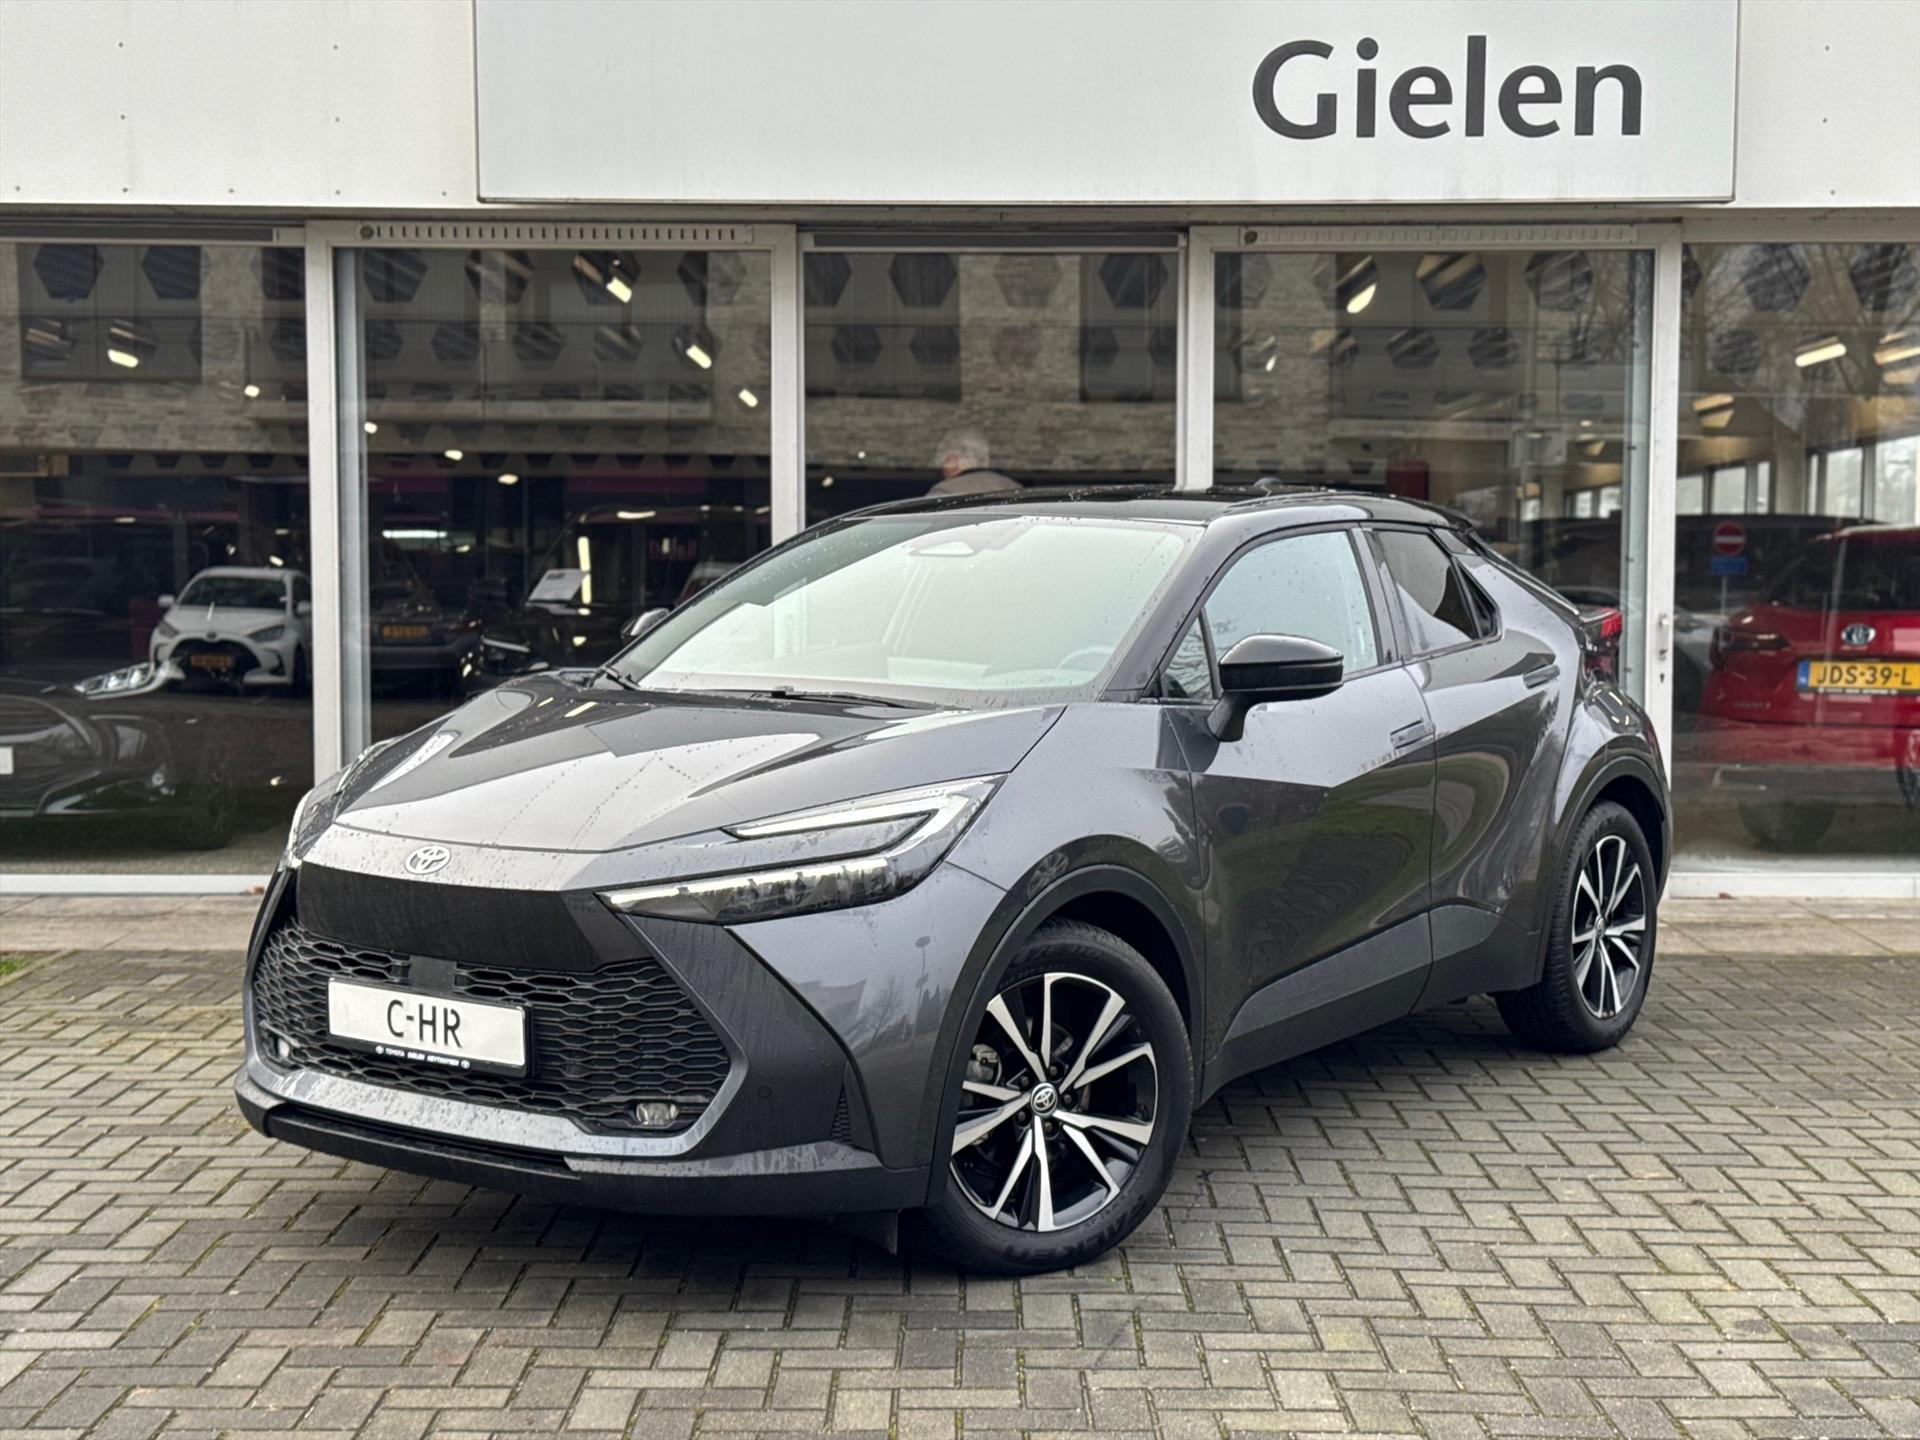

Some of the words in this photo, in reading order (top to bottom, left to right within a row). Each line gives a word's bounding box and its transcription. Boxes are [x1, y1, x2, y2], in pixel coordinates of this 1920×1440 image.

[1252, 35, 1642, 139] Gielen
[1817, 665, 1912, 686] JDS-39-L
[387, 999, 462, 1048] C-HR
